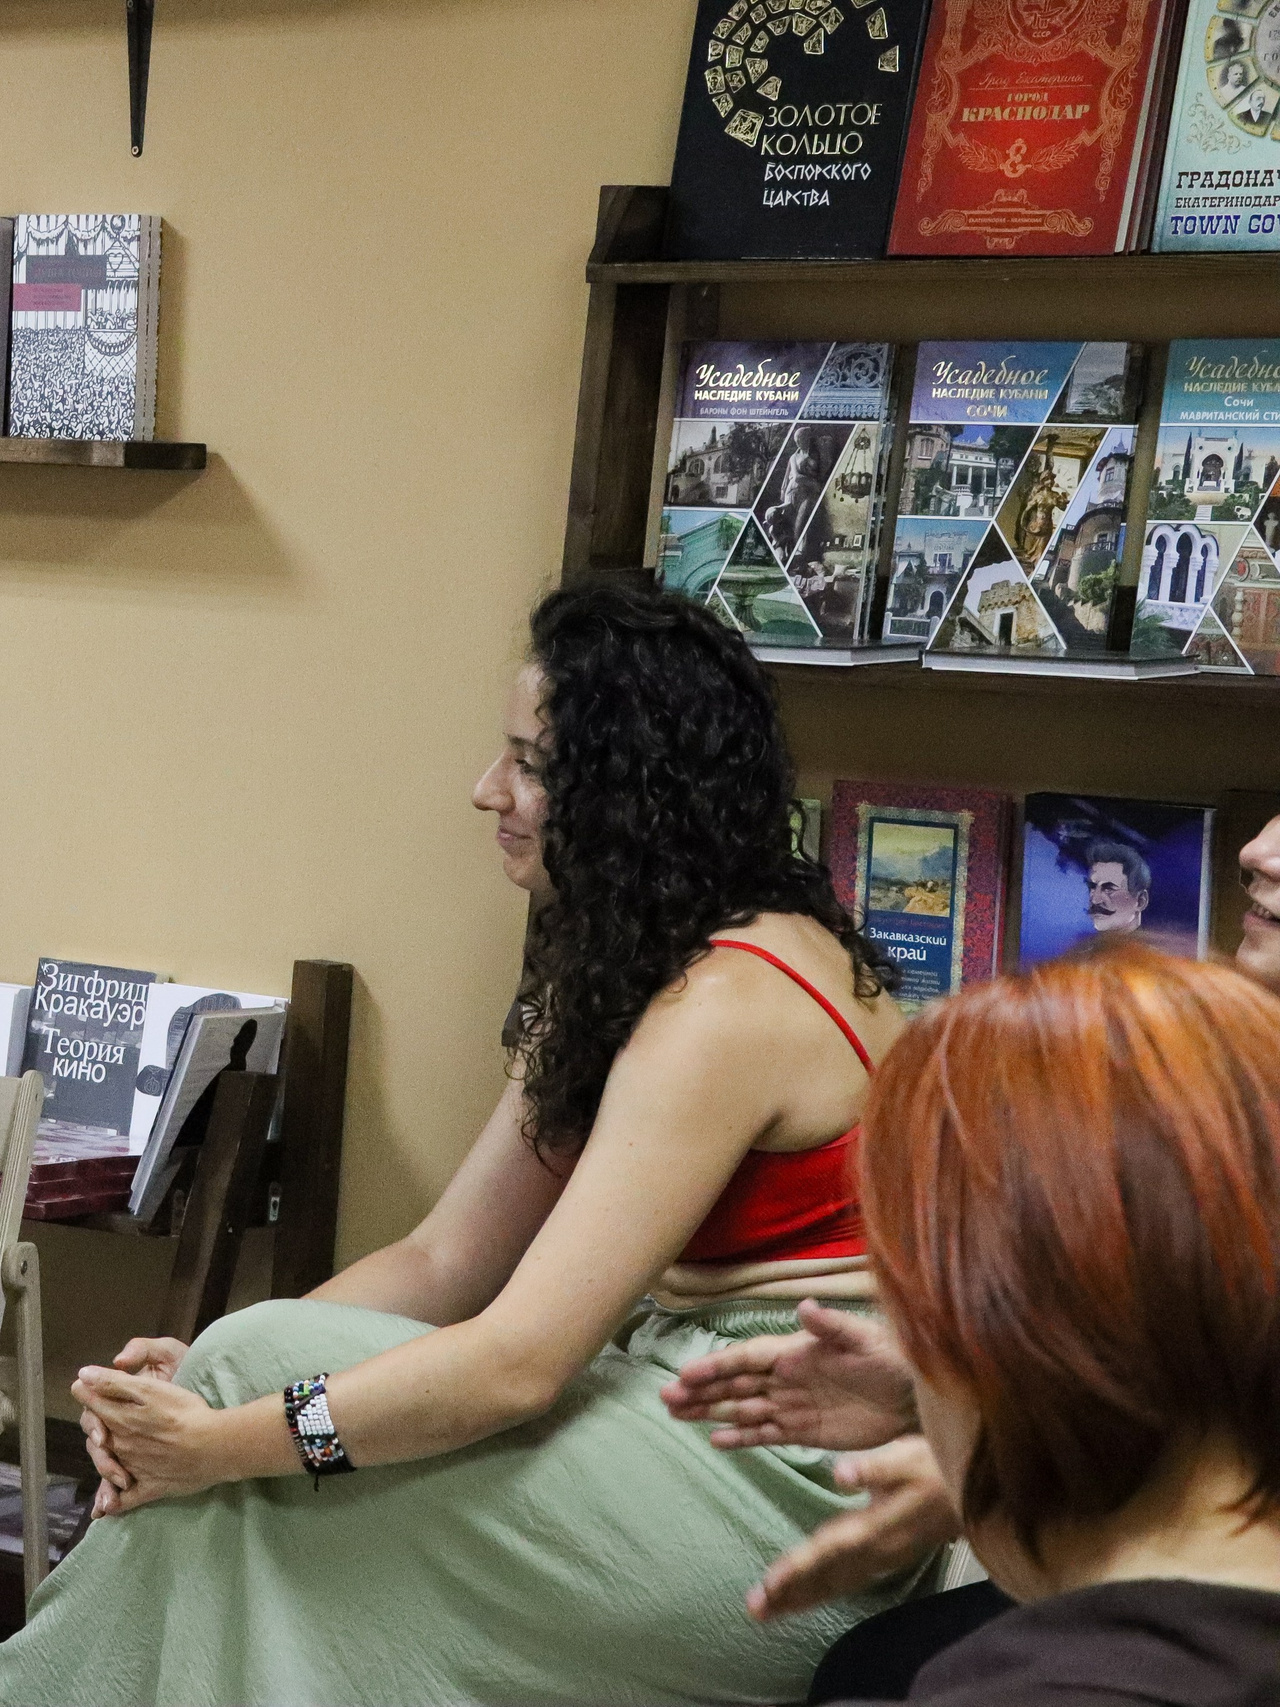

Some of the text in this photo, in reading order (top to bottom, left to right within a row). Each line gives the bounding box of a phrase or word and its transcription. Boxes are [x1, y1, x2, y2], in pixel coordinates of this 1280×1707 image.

[1007, 92, 1049, 103] ГОРОД
[764, 103, 883, 127] ЗОЛОТОЕ
[960, 104, 1091, 123] КРАСНОДАР
[760, 132, 863, 156] КОЛЬЦО
[764, 161, 872, 181] БОСПОРСКОГО
[1175, 169, 1280, 190] ГРАДОНА
[762, 188, 830, 208] ЦАРСТВА
[1174, 195, 1280, 208] ЕКАТЕРИНОДАР
[1170, 213, 1280, 235] TOWN GO
[695, 358, 801, 388] Усадебное
[932, 355, 1049, 385] Усадебное
[694, 390, 800, 402] НАСЛЕДИЕ КУБАНИ
[931, 388, 1049, 400] НАСЛЕДИЕ КУБАНИ
[1183, 382, 1280, 394] НАСЛЕДИЕ КУБА
[1224, 395, 1254, 407] Сочи
[700, 407, 789, 416] БАРОНЫ ФОН ШТЕЙНГЕЛЬ
[966, 404, 1008, 418] СОЧИ
[1179, 408, 1280, 421] МАВРИТАНСКИЙ СТИ
[869, 927, 947, 946] Закавказский
[887, 946, 927, 963] край
[40, 963, 149, 1006] Зигфрид
[34, 985, 146, 1031] Кракауэр
[41, 1025, 127, 1067] Теория
[52, 1057, 107, 1083] кино
